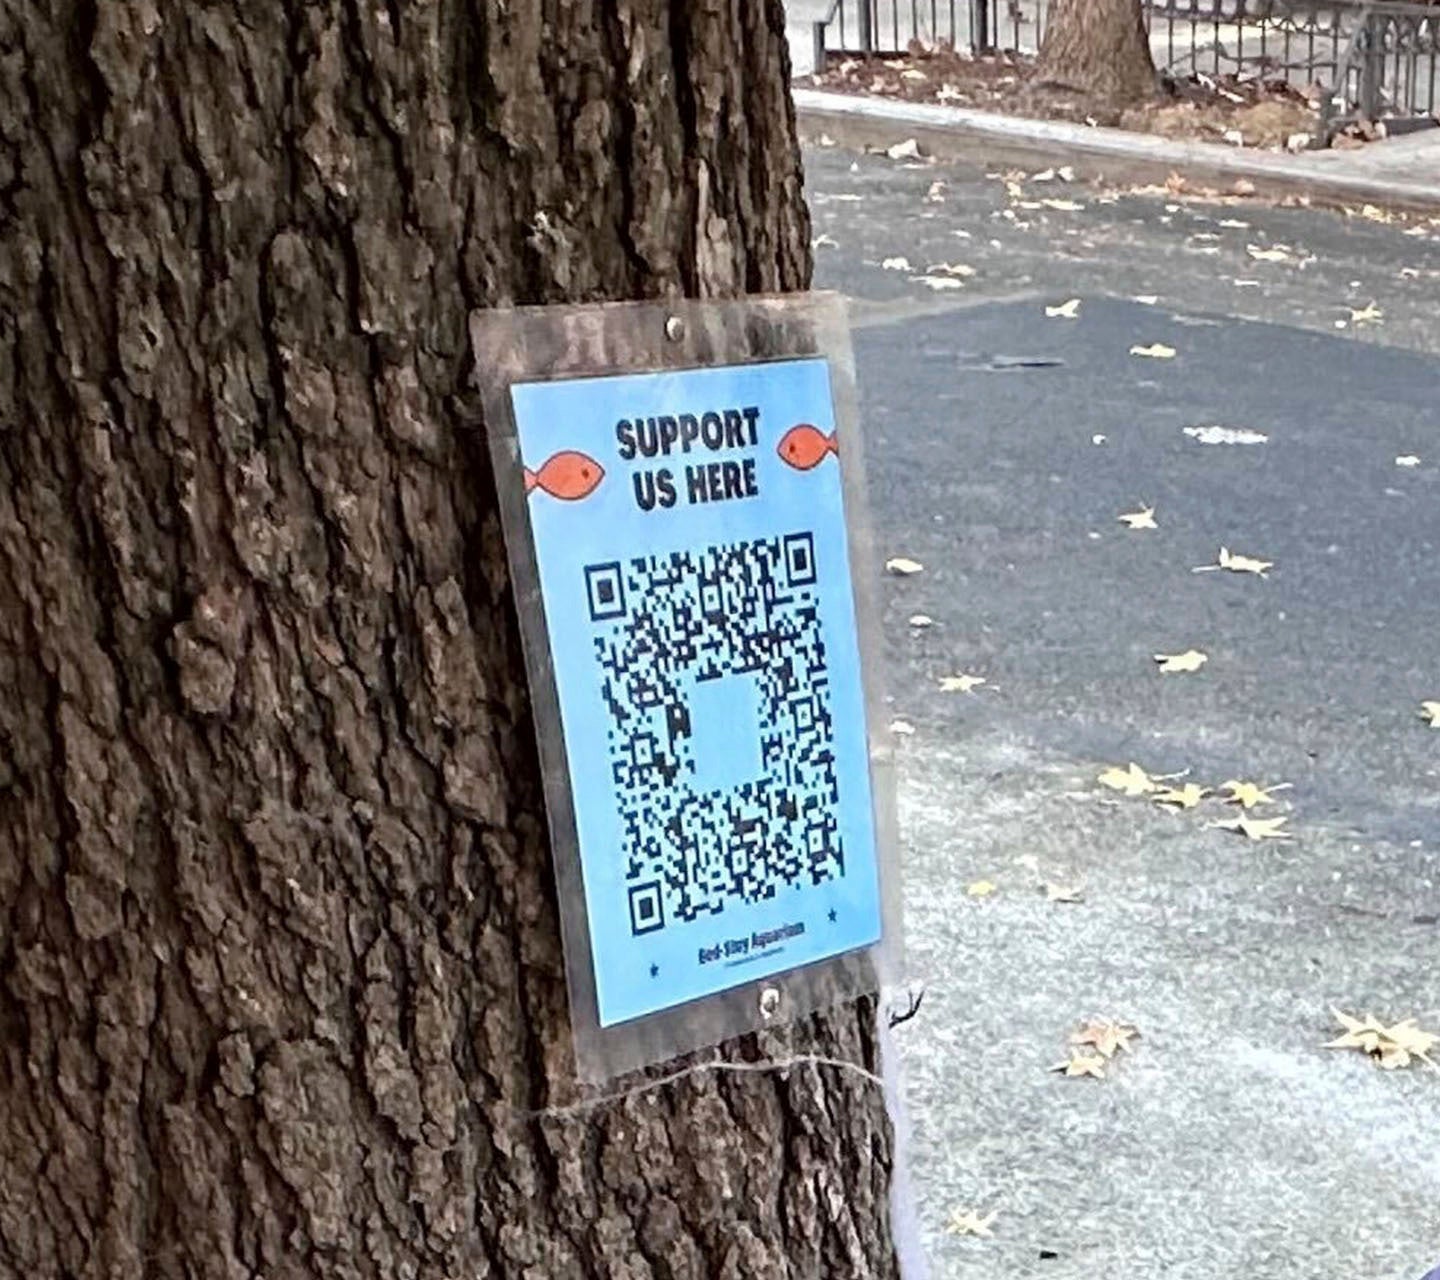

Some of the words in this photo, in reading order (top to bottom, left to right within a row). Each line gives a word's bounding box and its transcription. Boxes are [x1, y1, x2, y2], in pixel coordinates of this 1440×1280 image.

[616, 406, 759, 460] SUPPORT
[632, 468, 677, 512] US
[685, 457, 759, 504] HERE
